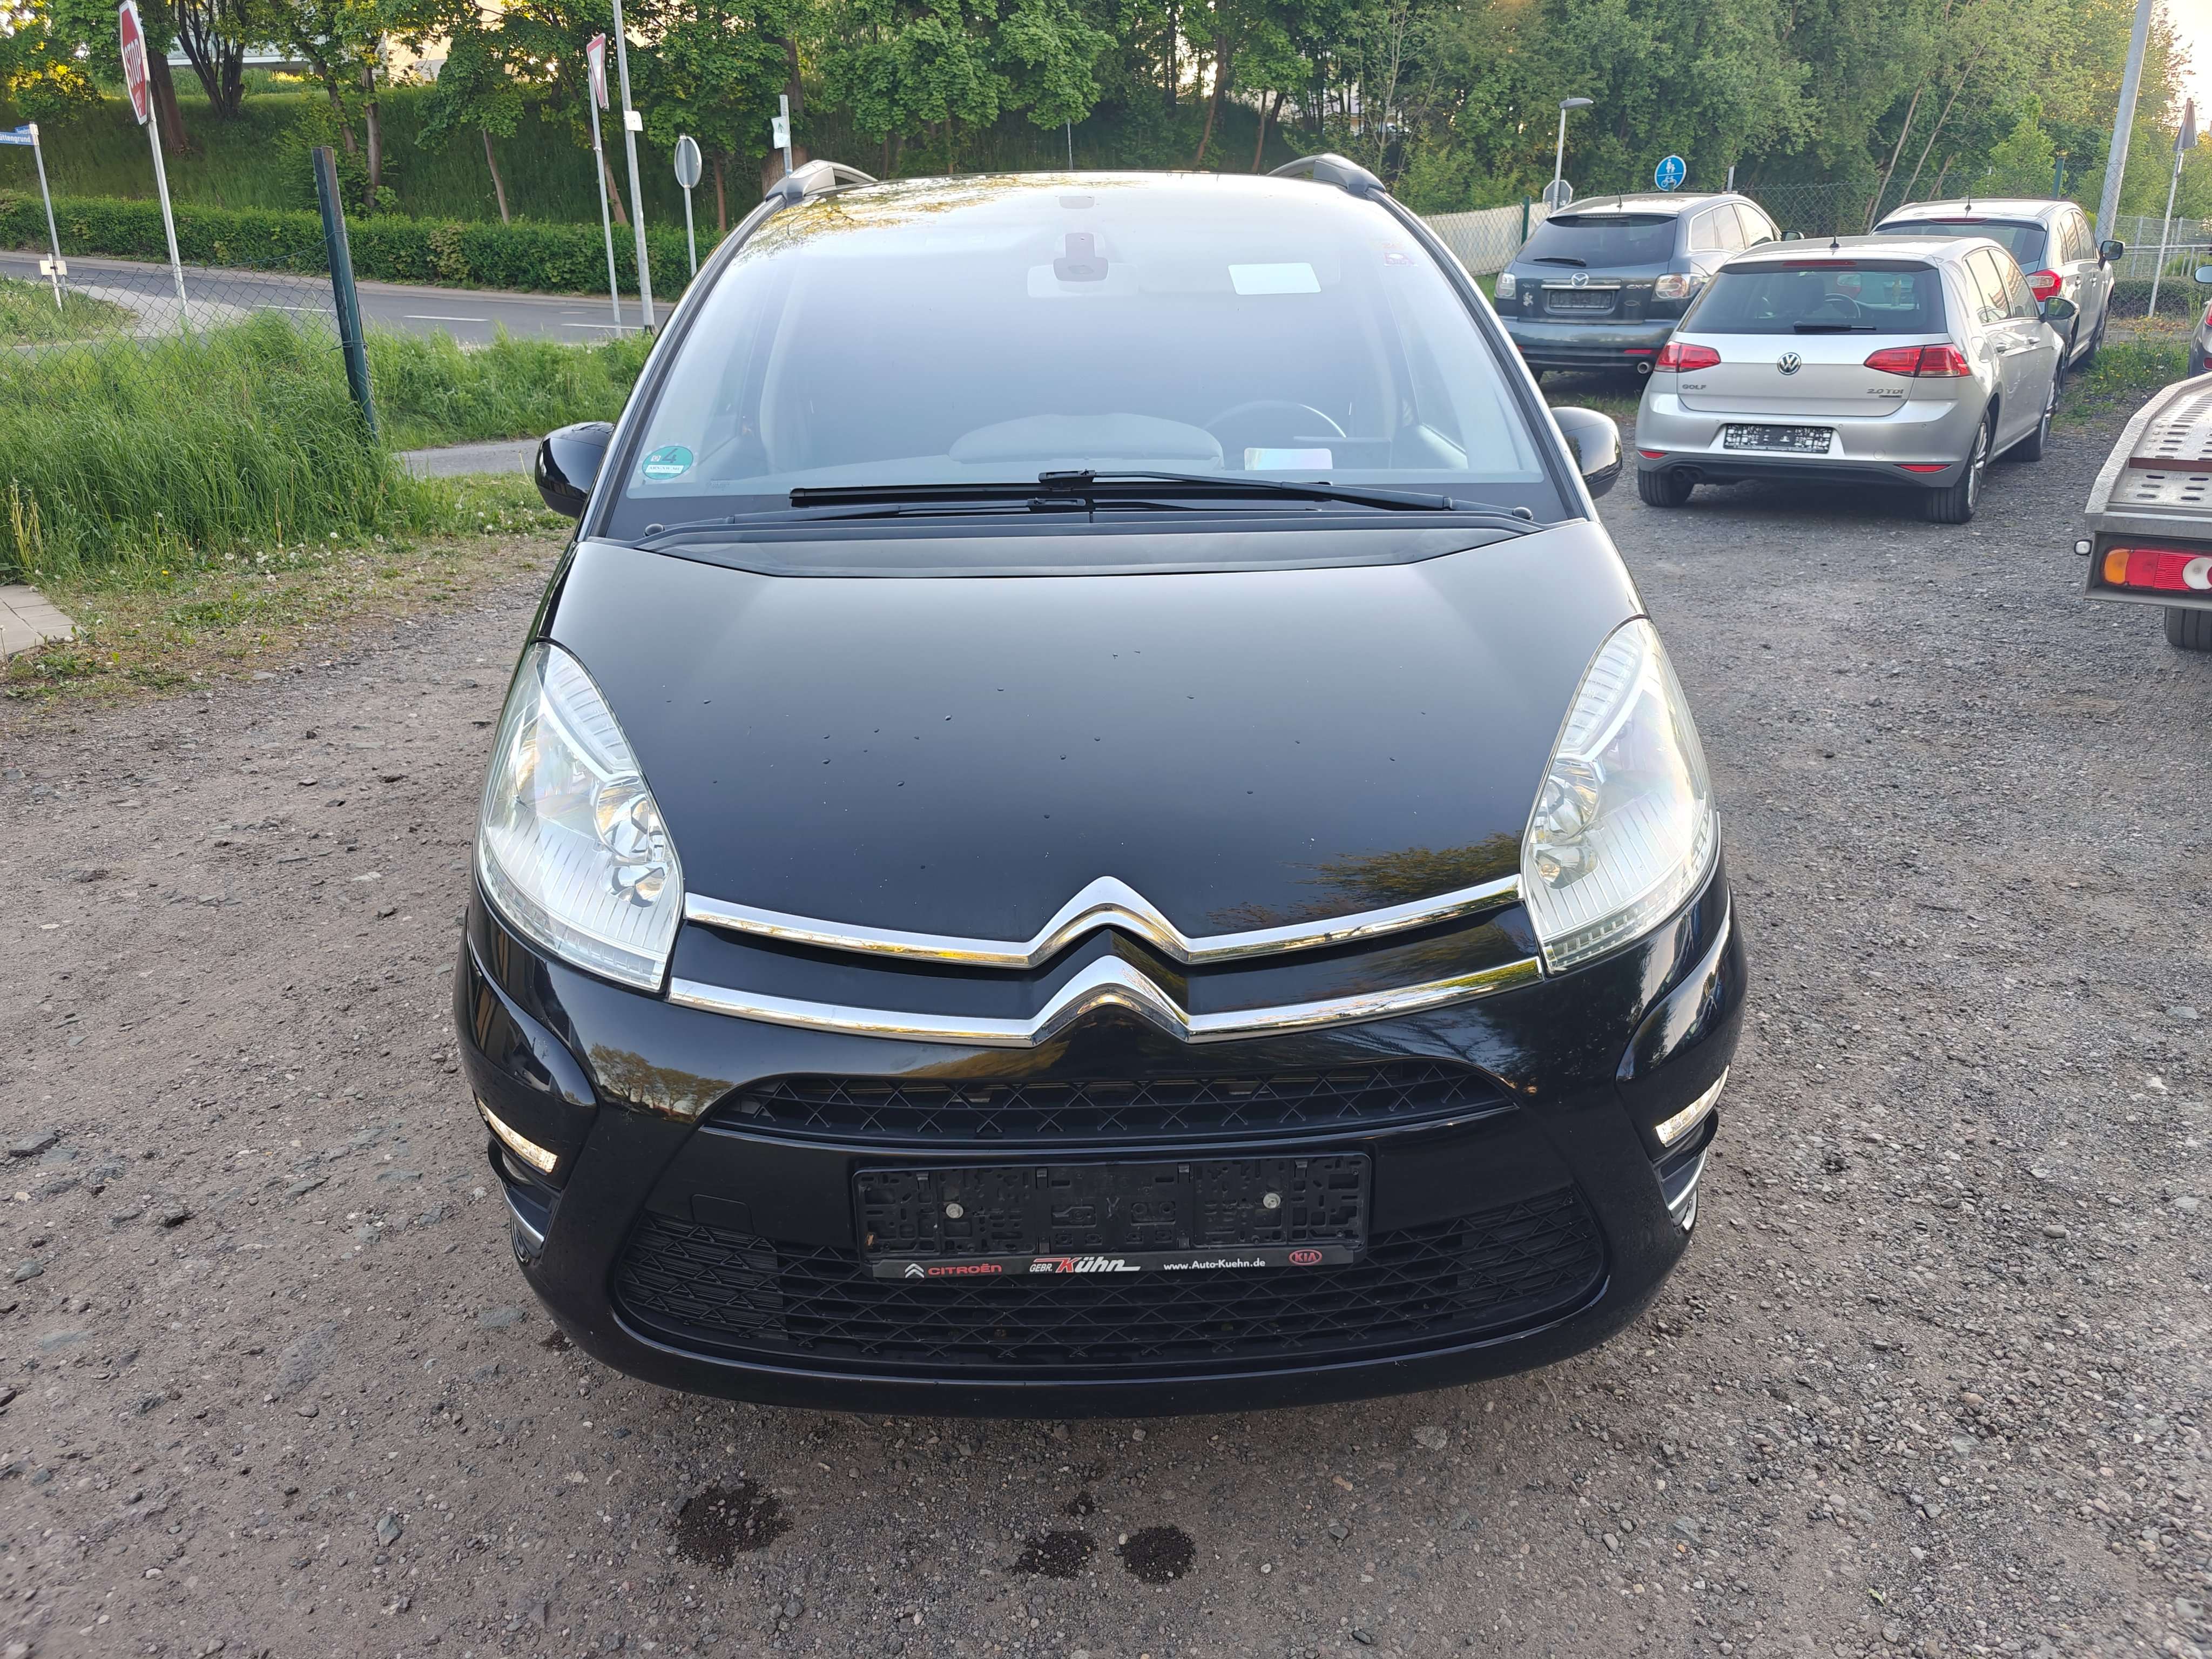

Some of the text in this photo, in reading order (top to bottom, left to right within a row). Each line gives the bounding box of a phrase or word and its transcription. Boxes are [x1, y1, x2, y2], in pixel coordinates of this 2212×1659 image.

[125, 38, 143, 89] STOP
[662, 448, 678, 463] 4
[1029, 1256, 1141, 1273] GEBR. Kühn
[1163, 1257, 1266, 1270] www.Auto-Kuehn.de
[1294, 1252, 1317, 1263] KIA
[928, 1263, 1002, 1276] CITROËN
